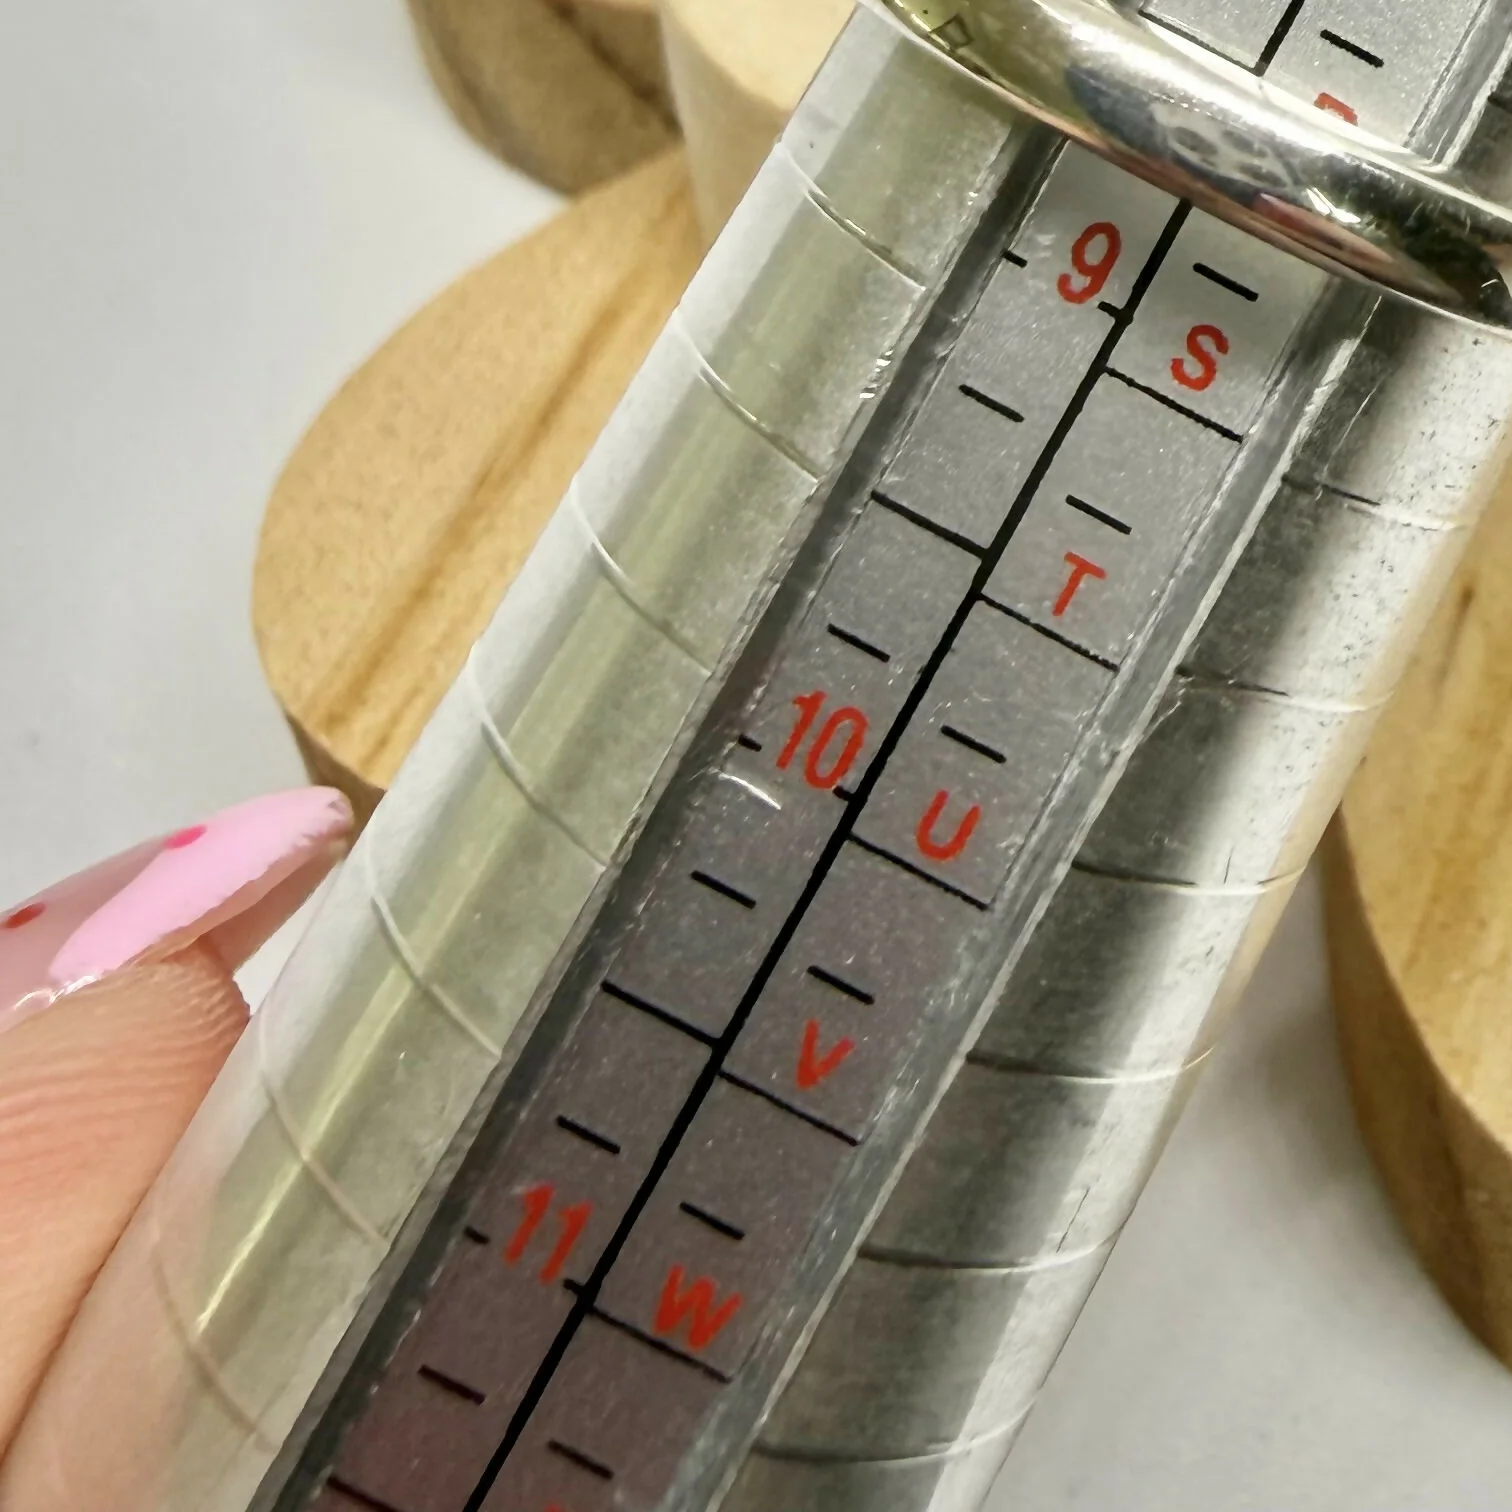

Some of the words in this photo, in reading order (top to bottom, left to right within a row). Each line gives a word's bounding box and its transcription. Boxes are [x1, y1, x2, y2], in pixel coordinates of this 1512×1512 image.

[1057, 222, 1121, 305] 9
[1170, 324, 1229, 392] S
[1052, 550, 1107, 617] T
[774, 690, 870, 791] 10
[915, 789, 982, 863] U
[795, 1018, 856, 1091] V
[503, 1182, 594, 1285] 11
[652, 1263, 744, 1353] W
